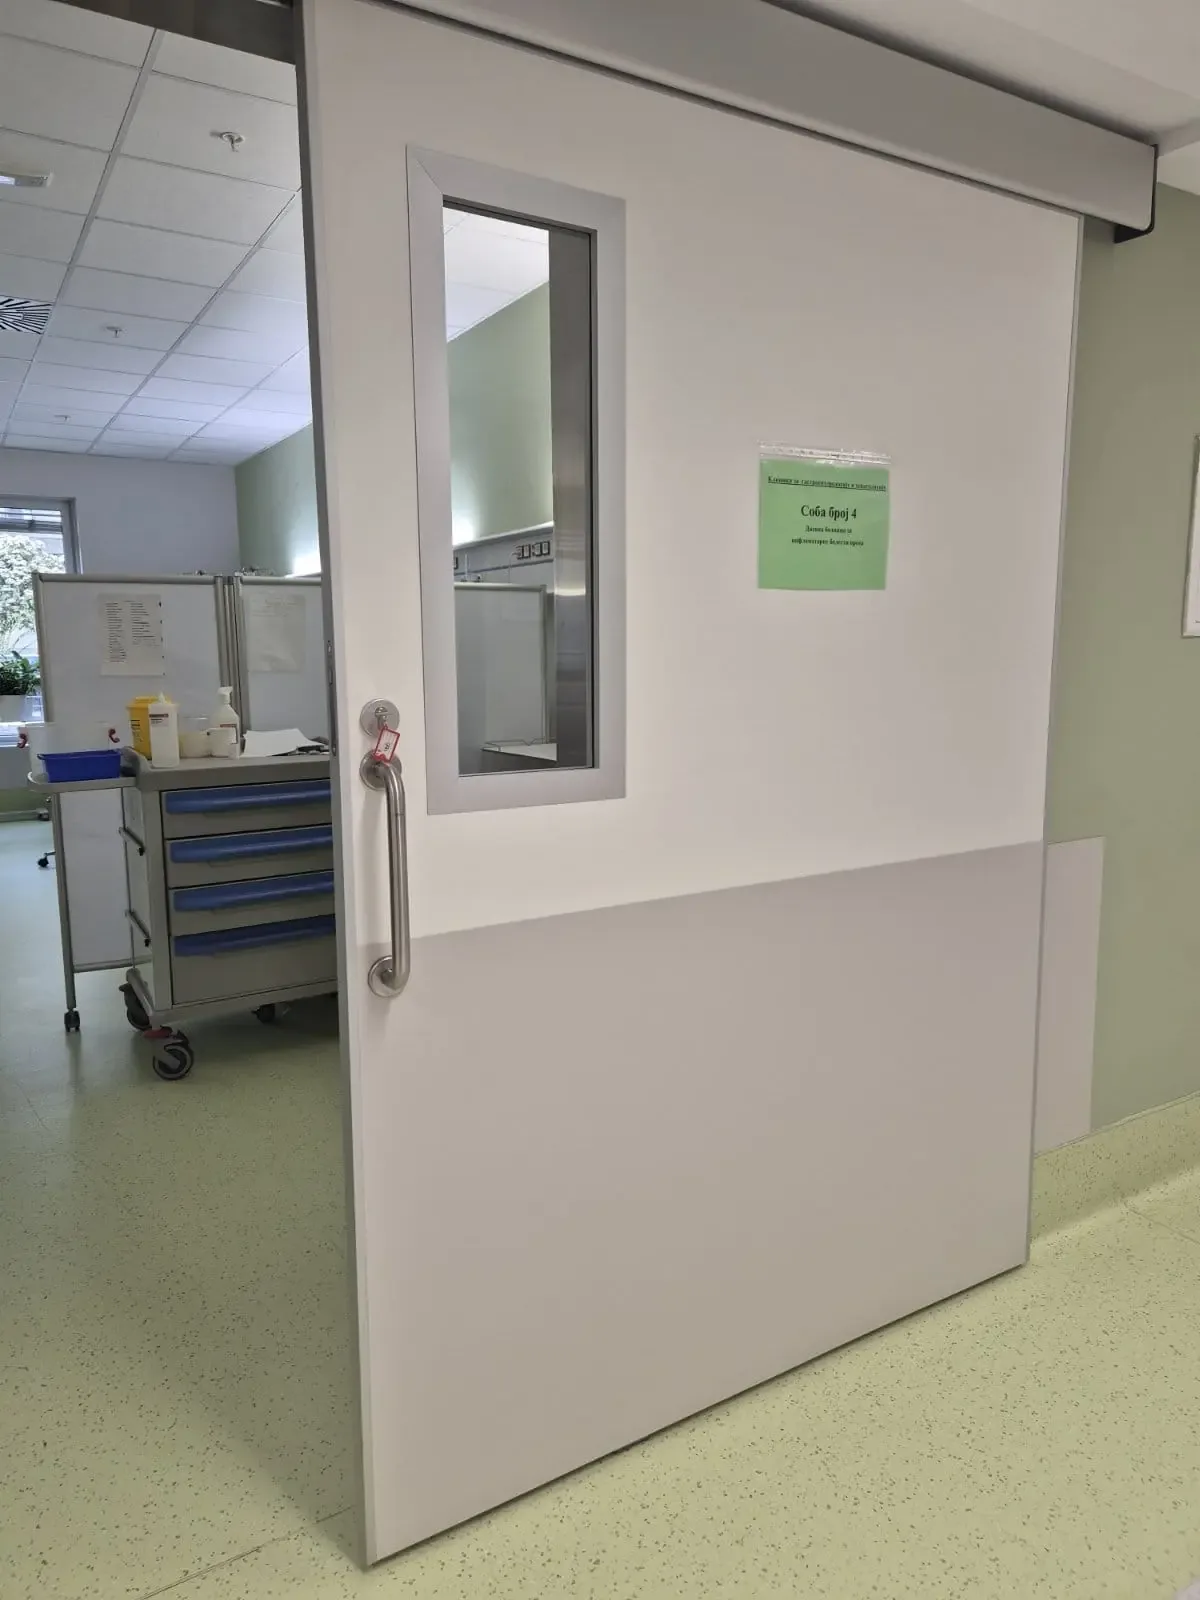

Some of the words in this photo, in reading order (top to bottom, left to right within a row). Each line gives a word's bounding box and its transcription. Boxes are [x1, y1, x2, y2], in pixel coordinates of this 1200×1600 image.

[801, 505, 826, 517] Соба
[828, 506, 849, 521] број
[851, 508, 857, 519] 4
